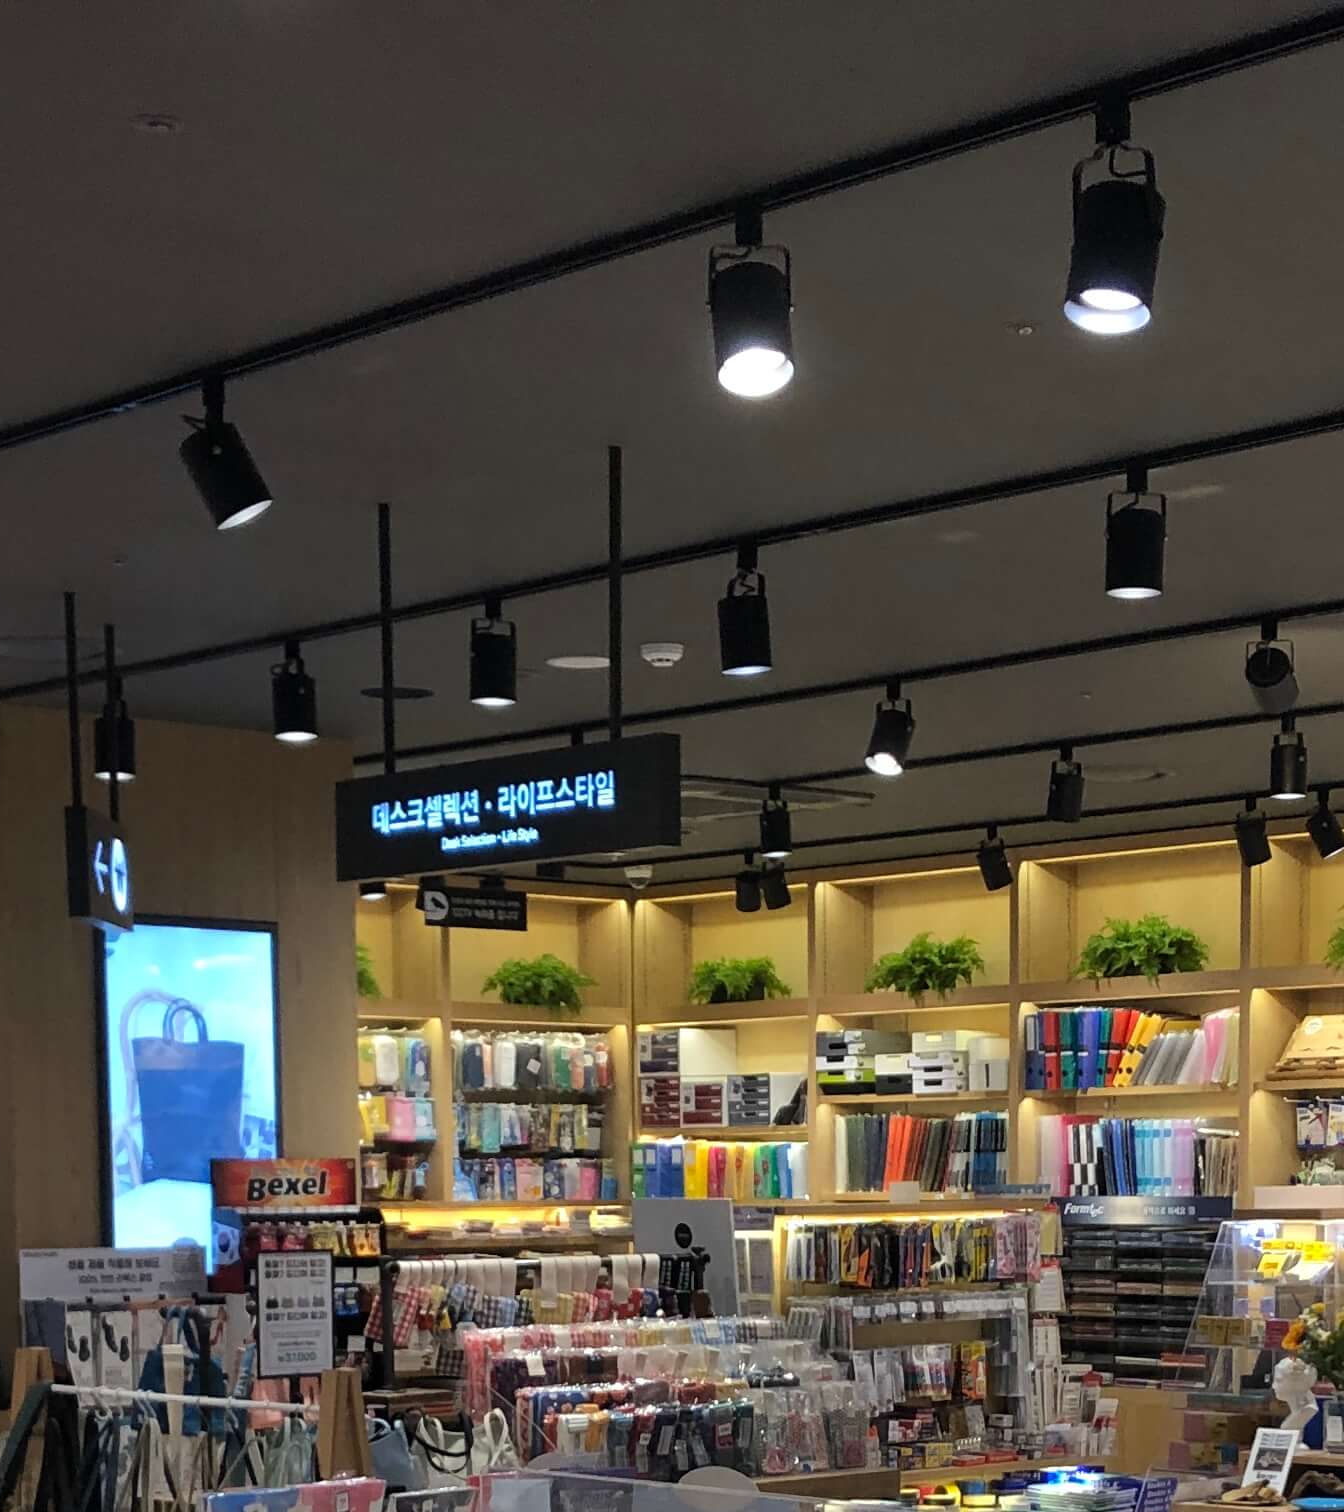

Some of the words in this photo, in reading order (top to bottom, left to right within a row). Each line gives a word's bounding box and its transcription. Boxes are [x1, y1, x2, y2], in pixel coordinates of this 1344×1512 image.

[372, 788, 480, 833] 데스크셀렉션
[497, 769, 616, 818] 라이프스타일
[246, 1170, 329, 1203] Bexel
